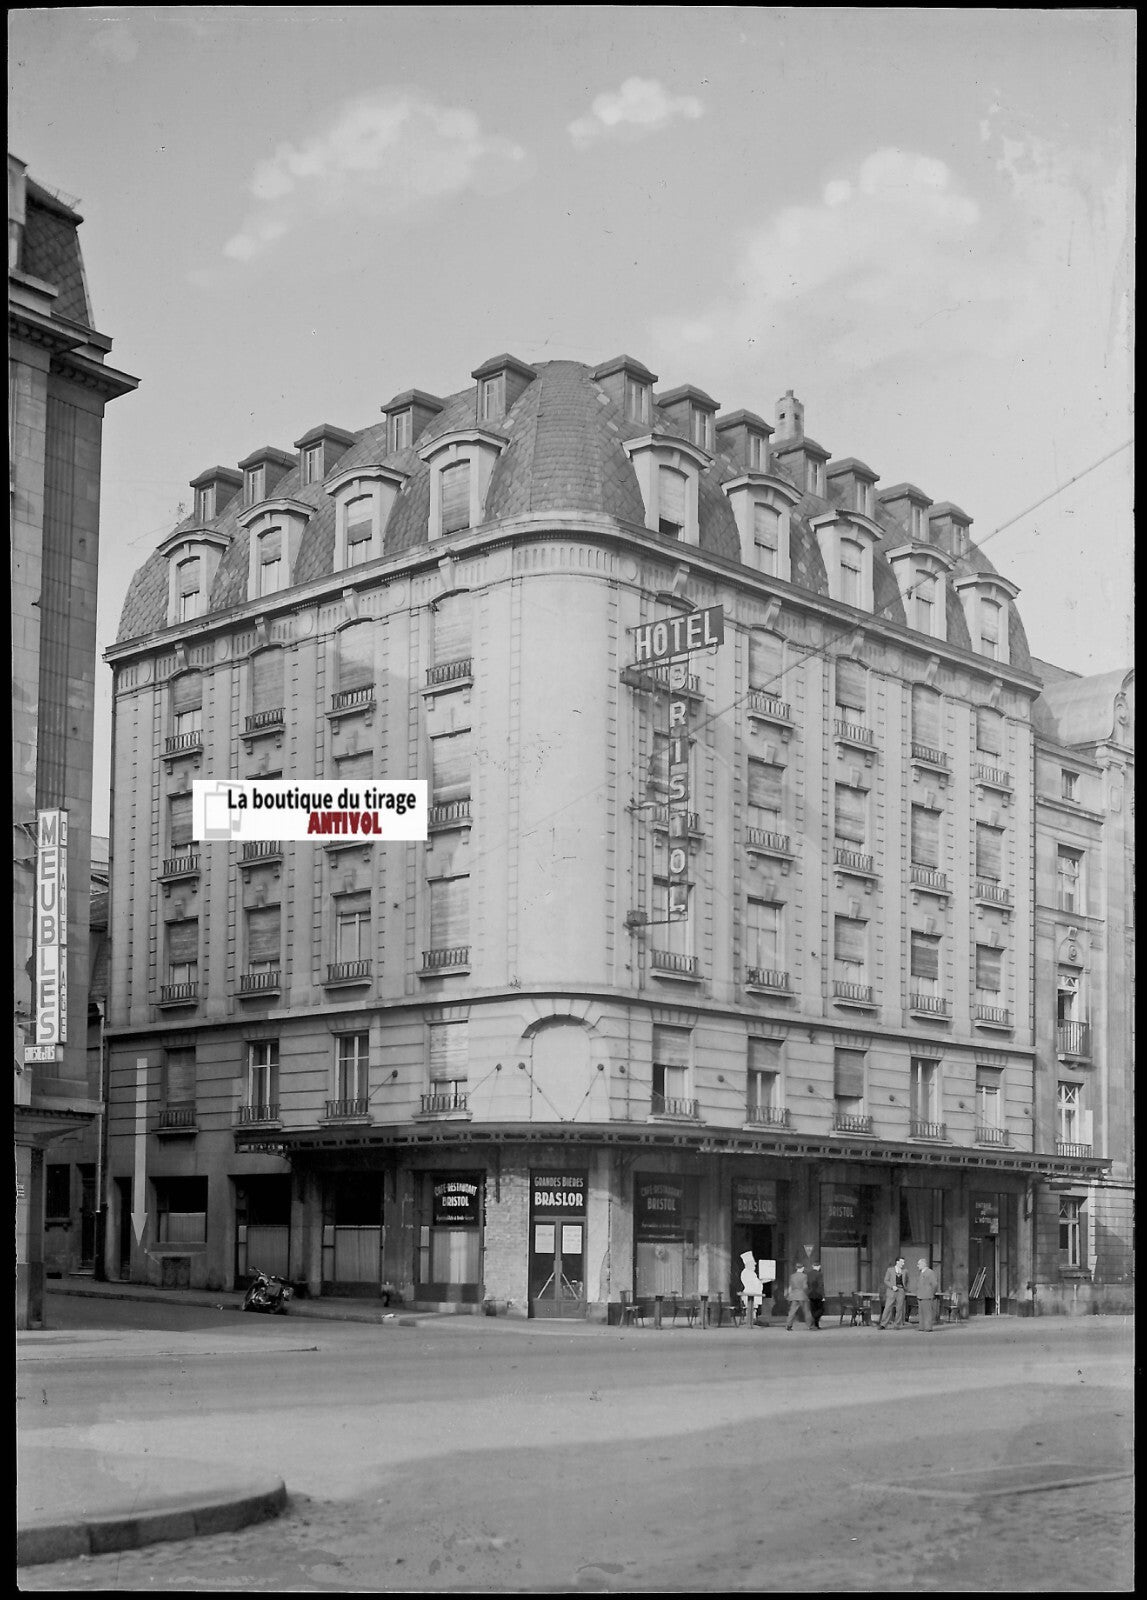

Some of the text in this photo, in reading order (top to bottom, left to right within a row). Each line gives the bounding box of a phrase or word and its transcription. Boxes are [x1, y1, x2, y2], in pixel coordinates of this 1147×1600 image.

[669, 664, 687, 913] BRISTOL
[40, 815, 57, 1040] MEUBLES
[534, 1176, 561, 1187] GRANDES
[442, 1196, 469, 1207] BRISTOL
[534, 1191, 584, 1206] BRASLOR
[647, 1197, 676, 1211] BRISTOL
[737, 1198, 773, 1212] BRASLOR
